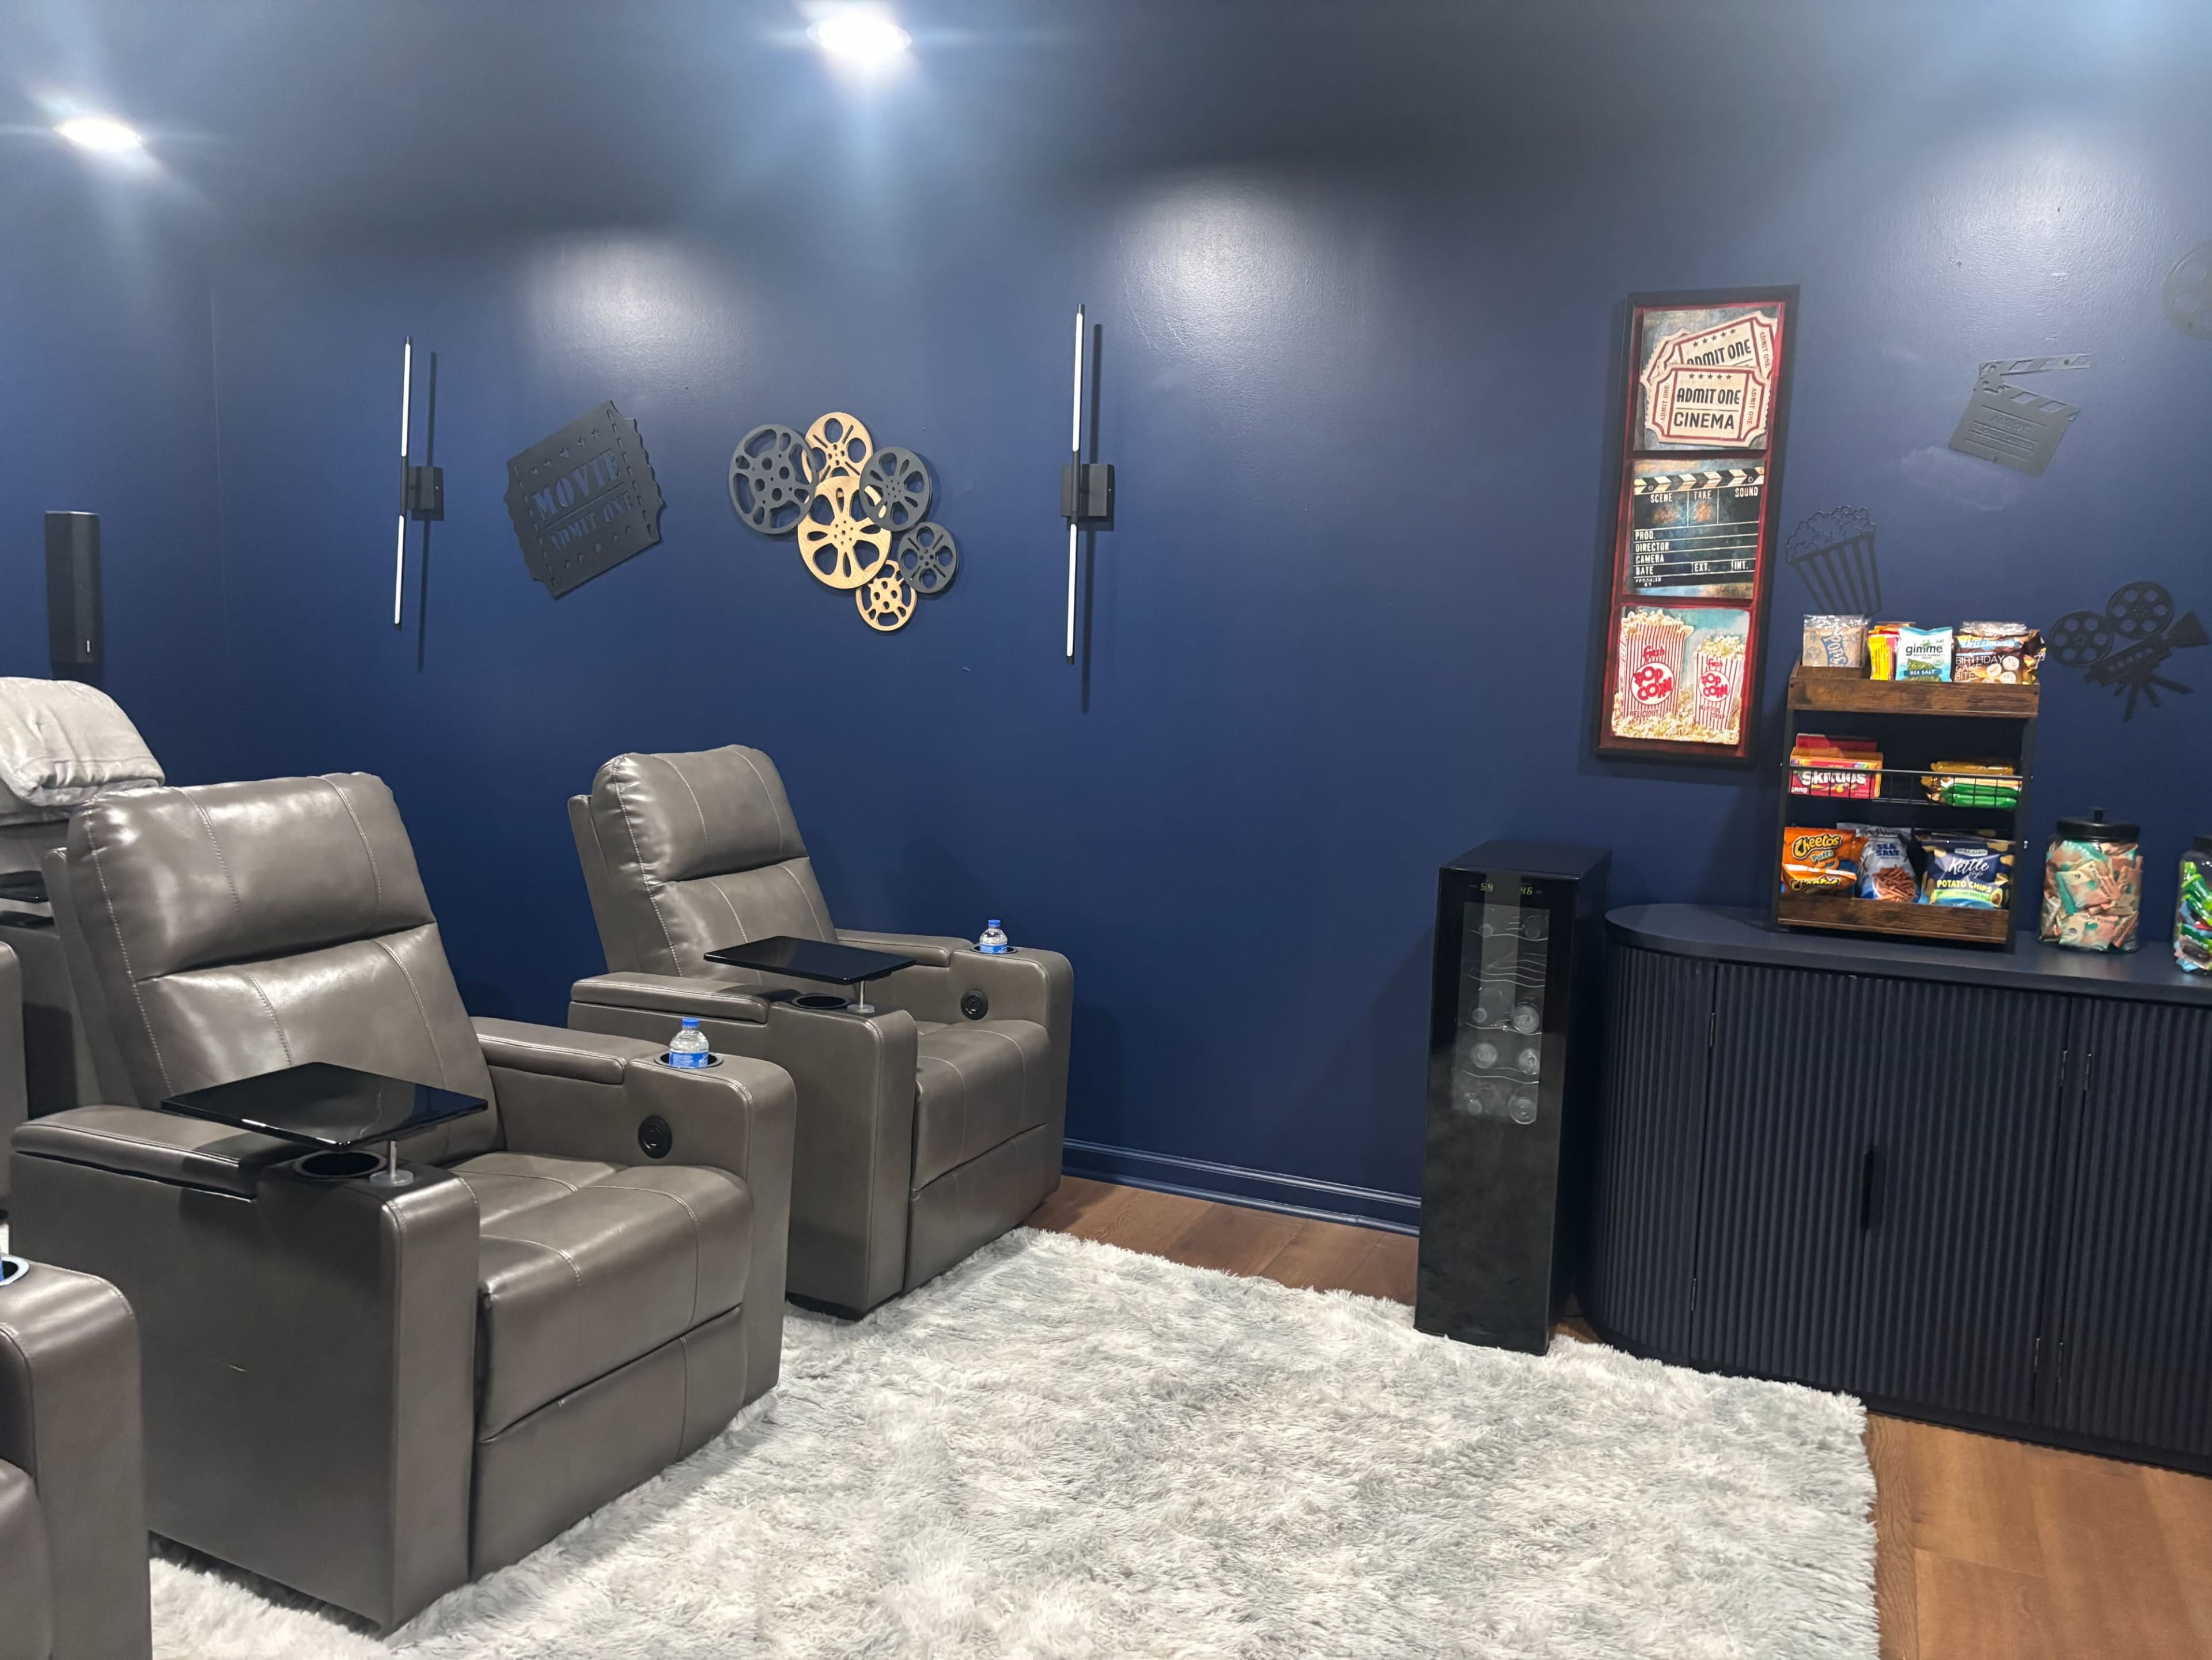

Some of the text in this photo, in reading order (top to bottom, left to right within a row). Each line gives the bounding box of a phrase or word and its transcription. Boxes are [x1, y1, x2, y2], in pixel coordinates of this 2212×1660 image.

[1759, 331, 1769, 354] ADMIT
[1728, 339, 1752, 359] ONE
[1677, 388, 1740, 405] ADMIT ONE
[1673, 412, 1734, 430] CINEMA
[533, 448, 620, 520] MOVIE
[1694, 490, 1712, 500] TAKE
[1734, 487, 1759, 497] SOUND
[1650, 493, 1673, 503] SCENE
[550, 493, 633, 551] ADMIT ONE
[1635, 531, 1656, 540] PROD.
[1635, 542, 1669, 552] DIRECTOR
[1635, 554, 1664, 564] CAMERA
[1694, 562, 1710, 572] EXT.
[1734, 560, 1749, 570] INT.
[1635, 566, 1654, 576] DATE
[1906, 644, 1943, 656] gimme
[1955, 655, 2005, 664] BIRTHDAY
[1956, 664, 1982, 673] CAKE
[1637, 677, 1672, 701] CORN
[1703, 684, 1728, 698] CORN
[1794, 834, 1841, 857] Cheetos
[1948, 857, 1990, 875] Kettle
[1480, 883, 1493, 891] 54
[1520, 887, 1533, 895] 46
[1937, 880, 1993, 893] POTATO CHIPS
